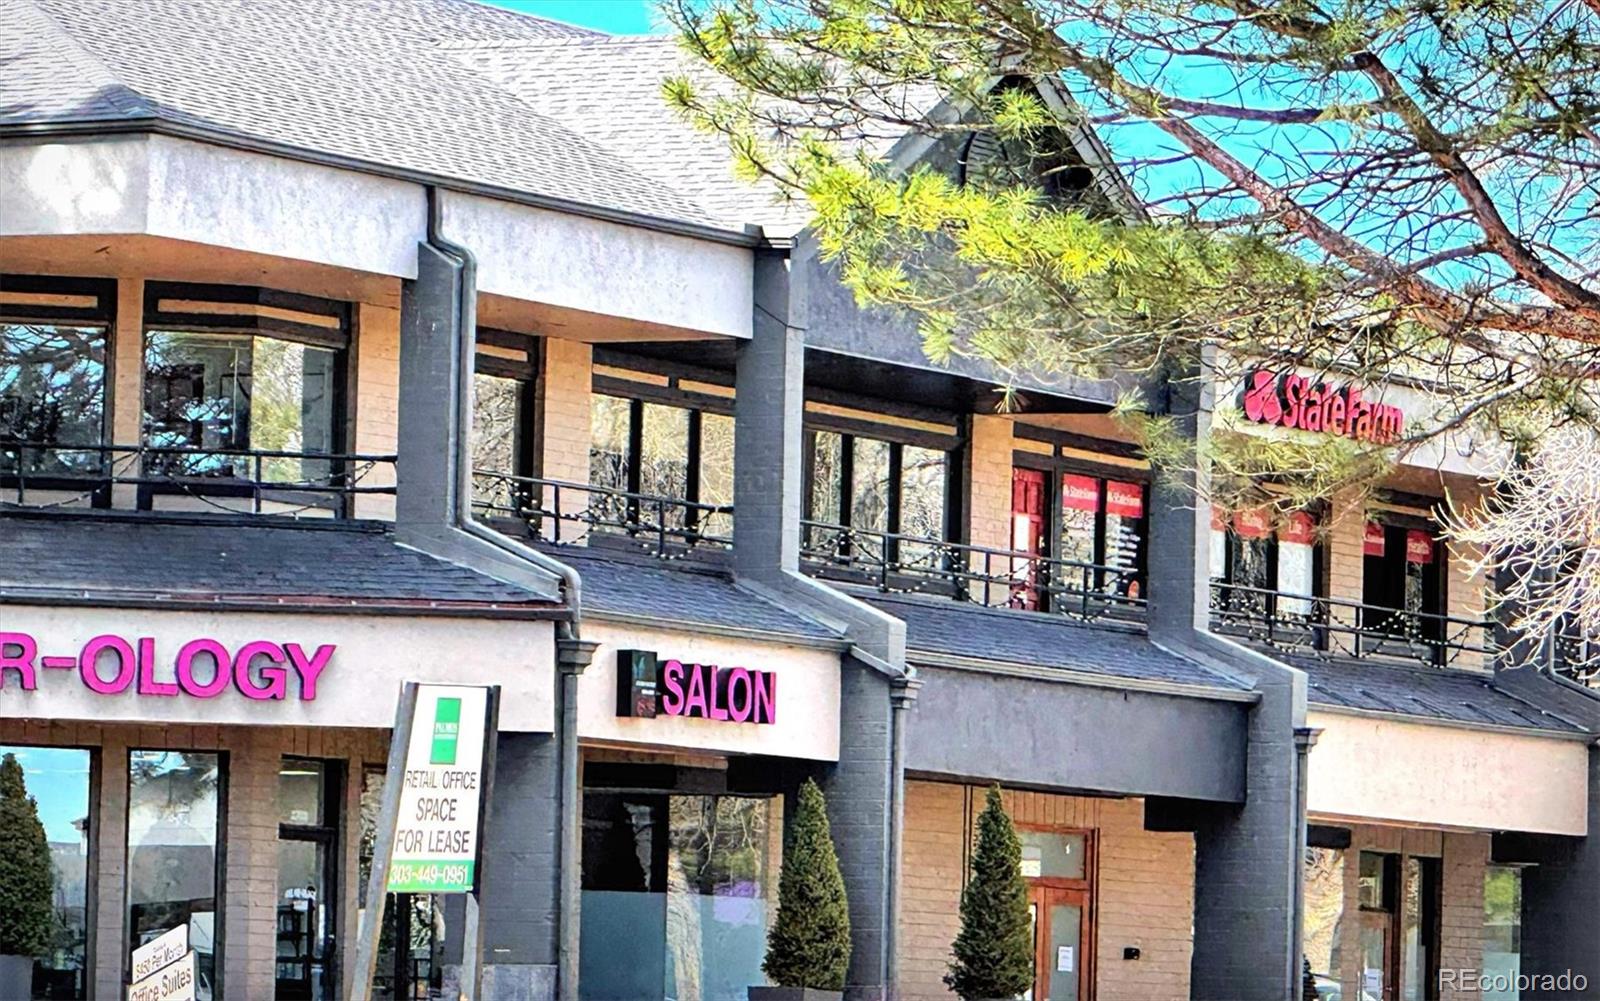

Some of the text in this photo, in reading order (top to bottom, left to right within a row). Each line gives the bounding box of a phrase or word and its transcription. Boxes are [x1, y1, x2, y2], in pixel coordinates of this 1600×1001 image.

[662, 659, 776, 725] SALON
[405, 770, 477, 790] RETAIL OFFICE
[415, 797, 457, 822] SPACE
[395, 829, 470, 854] FOR LEASE
[390, 864, 469, 886] 303-449-0951
[162, 967, 192, 998] Suites
